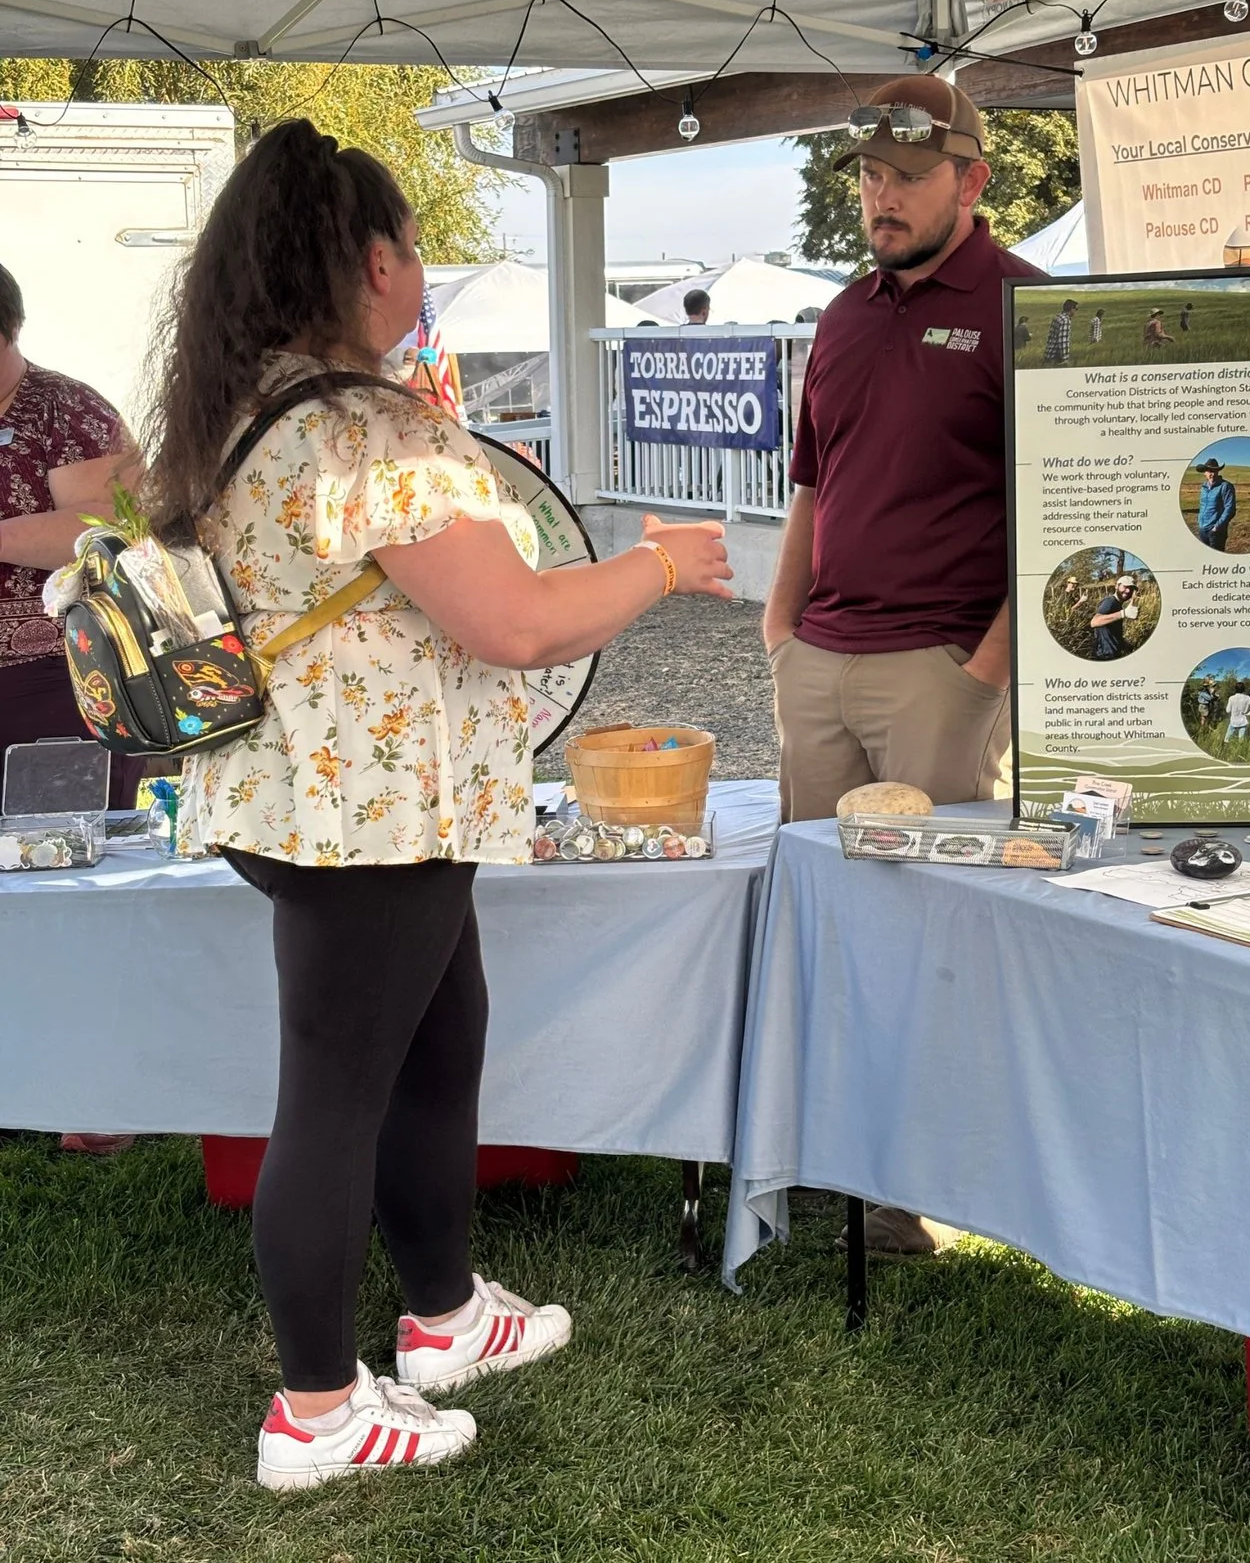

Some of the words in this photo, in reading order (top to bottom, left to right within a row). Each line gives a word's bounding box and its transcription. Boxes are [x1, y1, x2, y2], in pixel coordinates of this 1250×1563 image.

[1107, 62, 1234, 107] WHITMAN
[1112, 143, 1145, 161] Your
[1149, 135, 1187, 157] Local
[1142, 180, 1199, 201] Whitman
[1202, 177, 1222, 195] CD
[1146, 221, 1196, 239] Palouse
[1199, 217, 1219, 235] CD
[951, 328, 982, 340] PALOUSE
[946, 341, 977, 353] DISTRICT
[629, 352, 690, 380] TOBRA
[690, 352, 766, 381] COFFEE
[1084, 371, 1117, 384] What
[1119, 371, 1128, 383] is
[1131, 374, 1138, 382] a
[1141, 369, 1215, 382] conservation
[1066, 387, 1126, 399] Conservation
[1129, 386, 1167, 397] Districts
[1169, 385, 1179, 395] of
[1181, 383, 1237, 397] Washington
[631, 389, 763, 435] ESPRESSO
[1043, 456, 1074, 468] What
[1077, 456, 1091, 467] do
[1094, 458, 1111, 467] we
[1113, 455, 1134, 466] do?
[1043, 472, 1058, 482] We
[1061, 471, 1084, 481] work
[1086, 470, 1122, 482] through
[1124, 469, 1170, 481] voluntary,
[538, 500, 560, 529] What
[558, 534, 572, 552] are
[1202, 564, 1229, 576] How
[1232, 563, 1246, 575] do
[1045, 678, 1071, 689] Who
[1074, 677, 1088, 689] do
[1091, 679, 1108, 688] we
[1110, 676, 1146, 688] serve?
